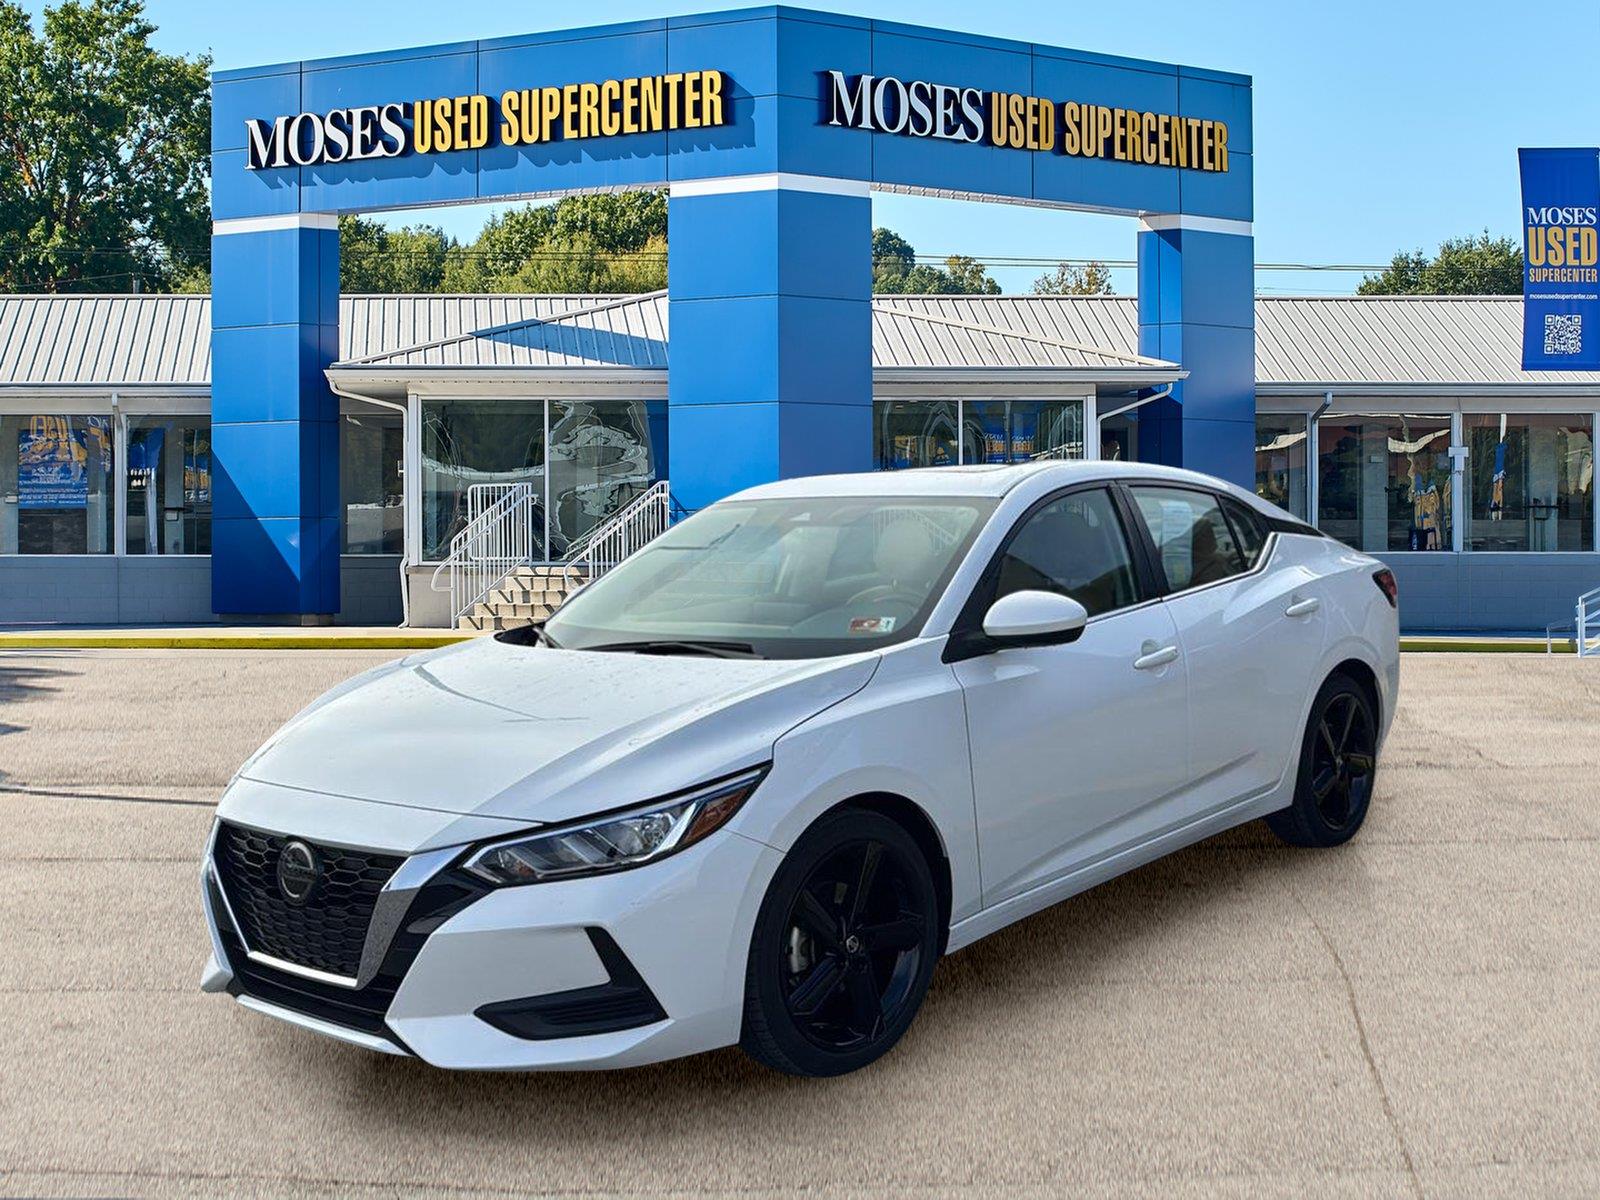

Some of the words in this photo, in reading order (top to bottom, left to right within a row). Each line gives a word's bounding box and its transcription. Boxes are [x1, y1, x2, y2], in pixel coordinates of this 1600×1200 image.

[244, 103, 408, 170] MOSES
[414, 94, 488, 154] USED
[501, 70, 723, 145] SUPERCENTER
[829, 70, 984, 143] MOSES
[991, 92, 1055, 151] USED
[1065, 101, 1229, 172] SUPERCENTER
[1528, 207, 1597, 225] MOSES
[1529, 227, 1597, 266] USED
[1529, 268, 1597, 283] SUPERCENTER
